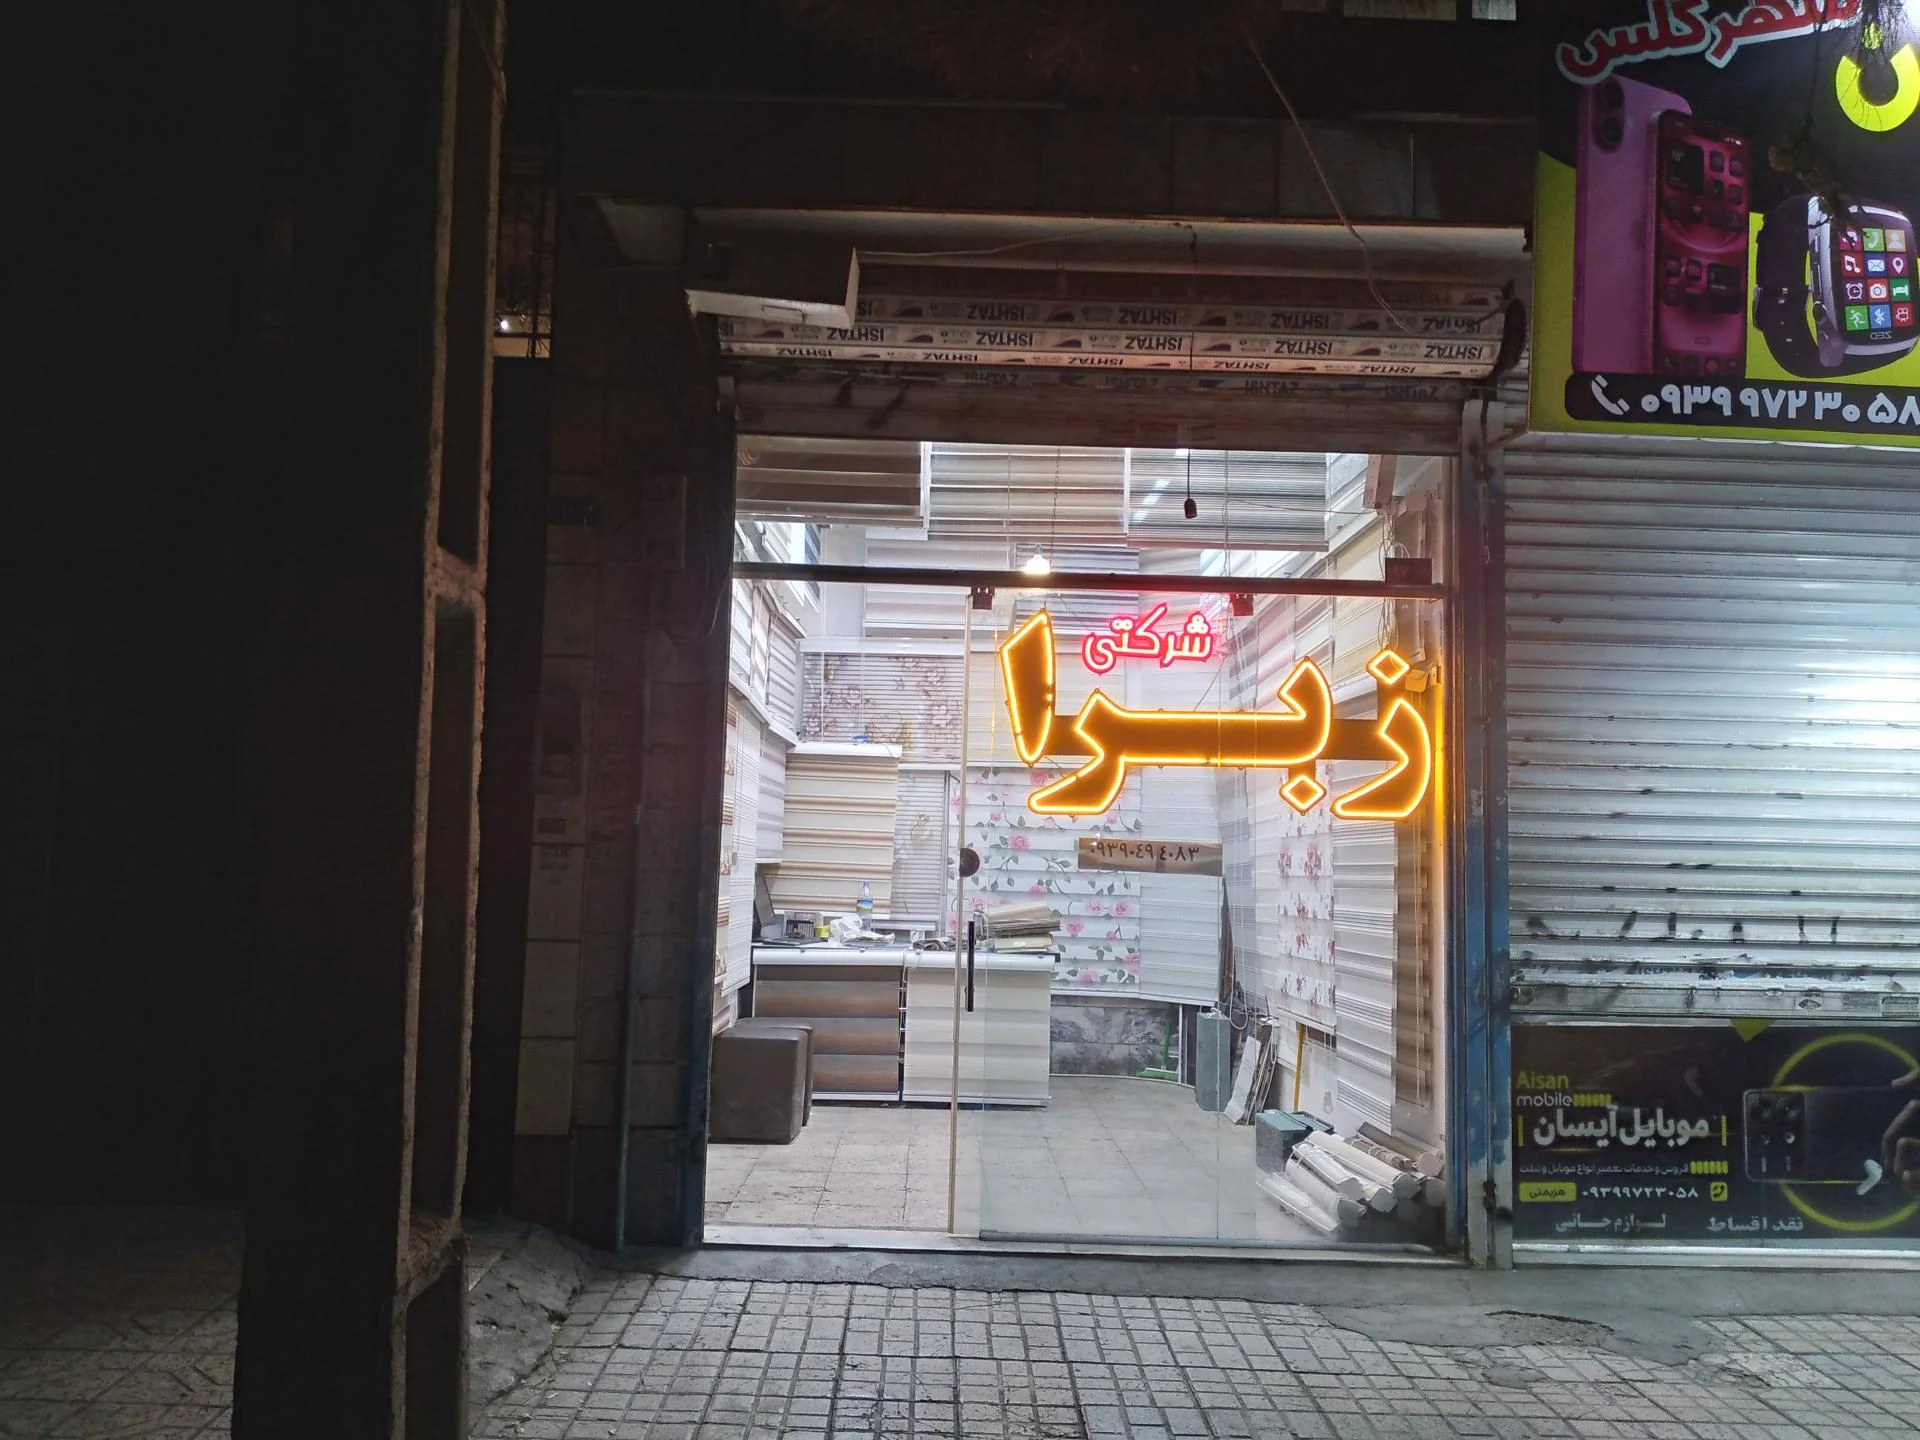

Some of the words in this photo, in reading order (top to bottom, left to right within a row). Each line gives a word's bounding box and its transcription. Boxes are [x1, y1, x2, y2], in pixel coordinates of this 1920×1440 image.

[1083, 603, 1215, 674] شرکتی
[999, 608, 1433, 824] زبرا
[1516, 1071, 1569, 1089] Aisan
[1516, 1092, 1573, 1107] mobile
[1533, 1104, 1618, 1147] آیسان
[1619, 1108, 1710, 1146] موبایل
[1555, 1212, 1612, 1233] جانبی
[1613, 1212, 1667, 1233] لوازم
[1706, 1215, 1767, 1232] اقساط
[1772, 1216, 1804, 1232] نقد
